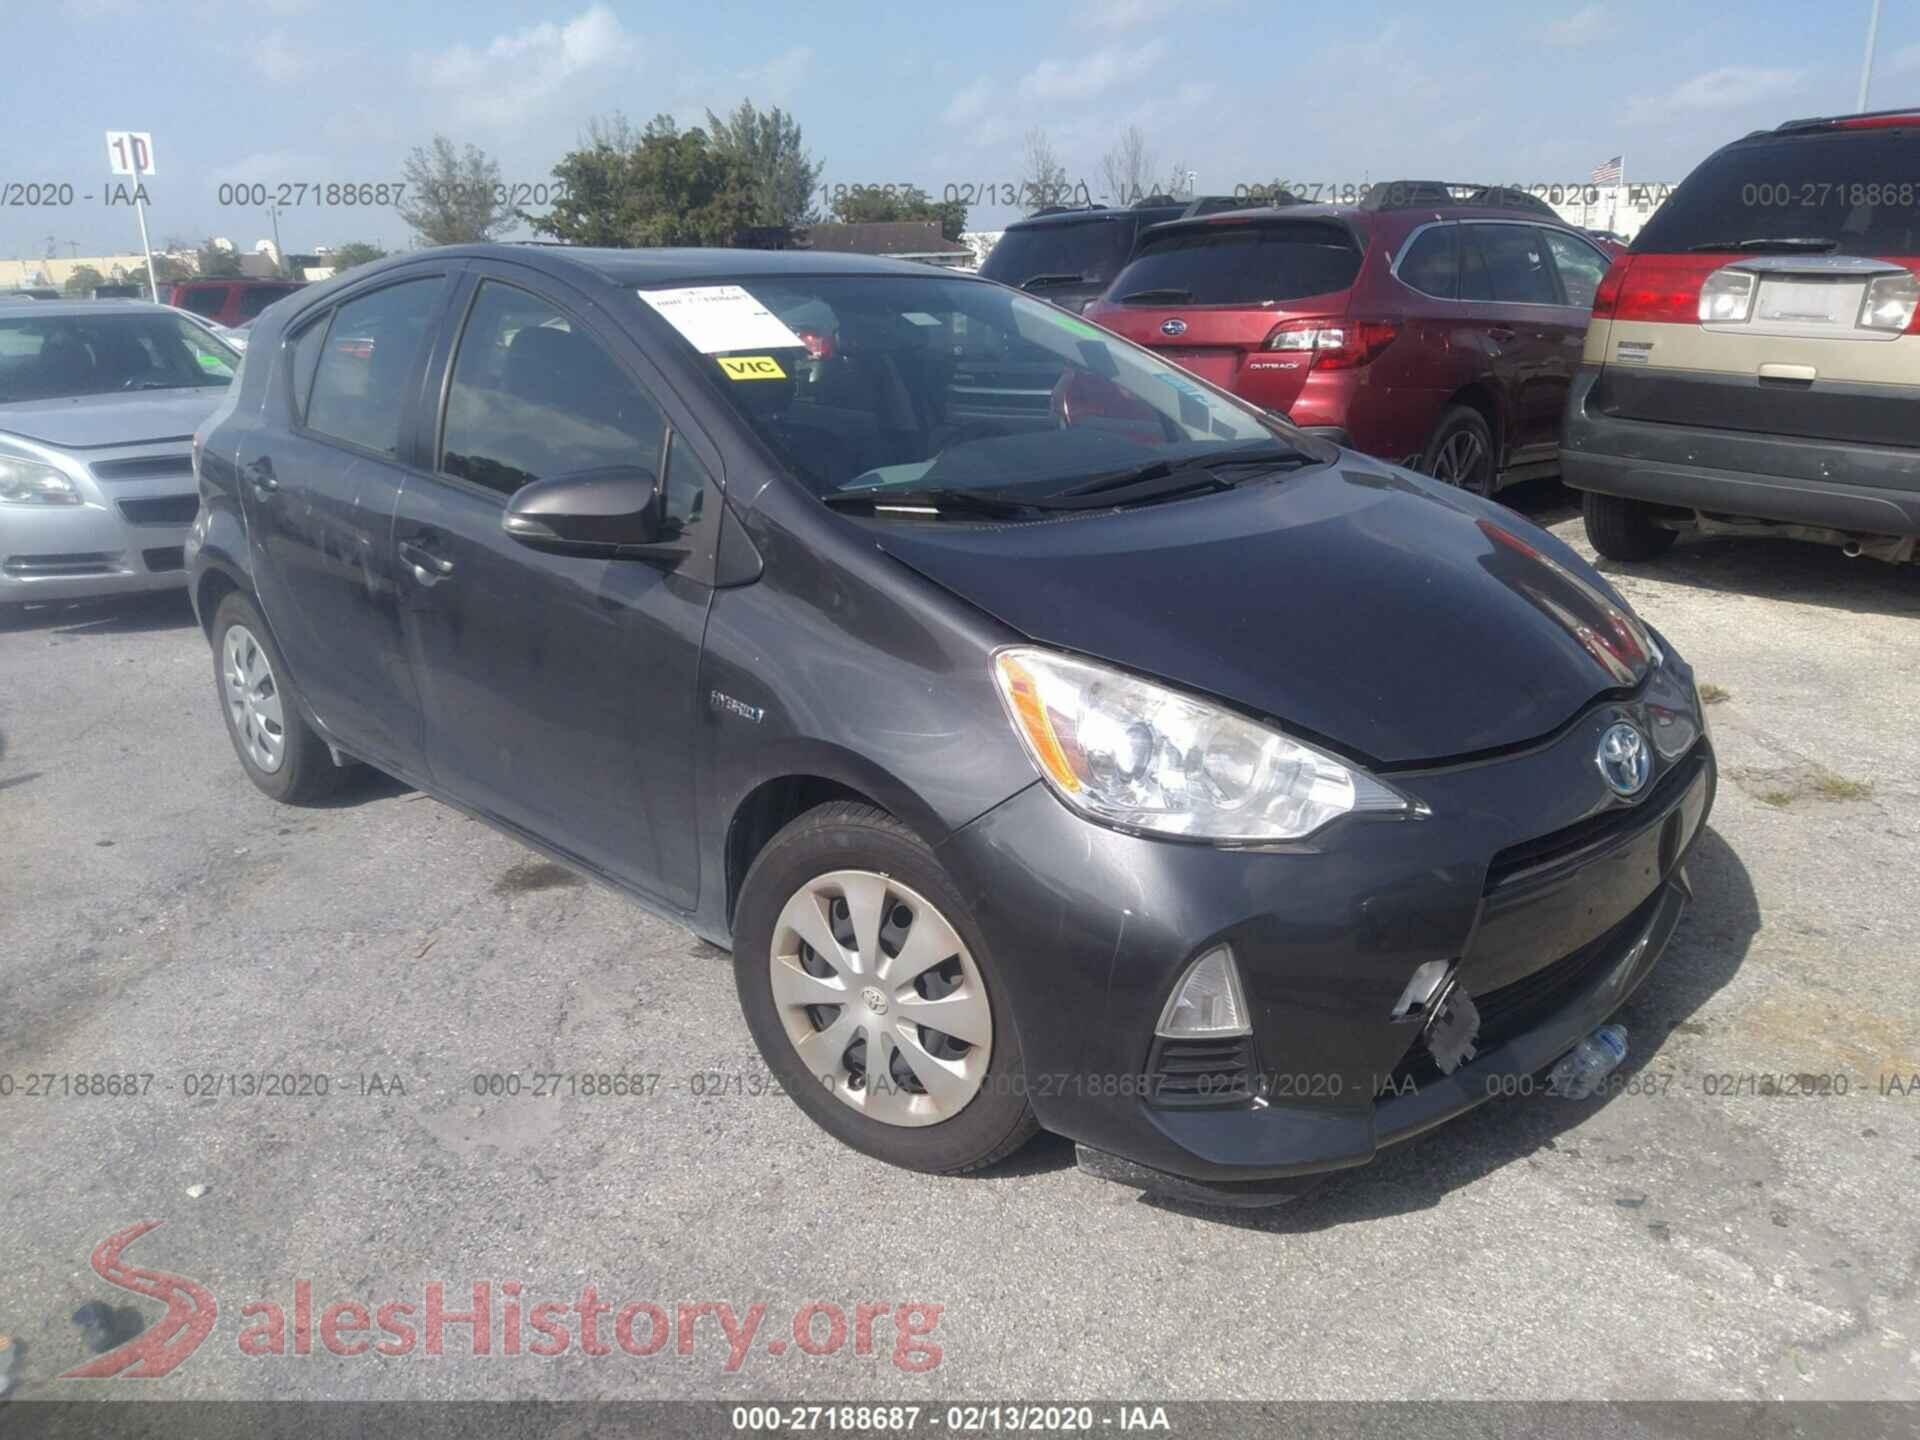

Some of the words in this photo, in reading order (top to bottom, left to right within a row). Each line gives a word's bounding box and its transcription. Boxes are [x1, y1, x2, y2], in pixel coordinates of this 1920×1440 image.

[112, 137, 149, 171] 10
[725, 360, 777, 375] VIC
[1250, 362, 1301, 371] OUTBACK
